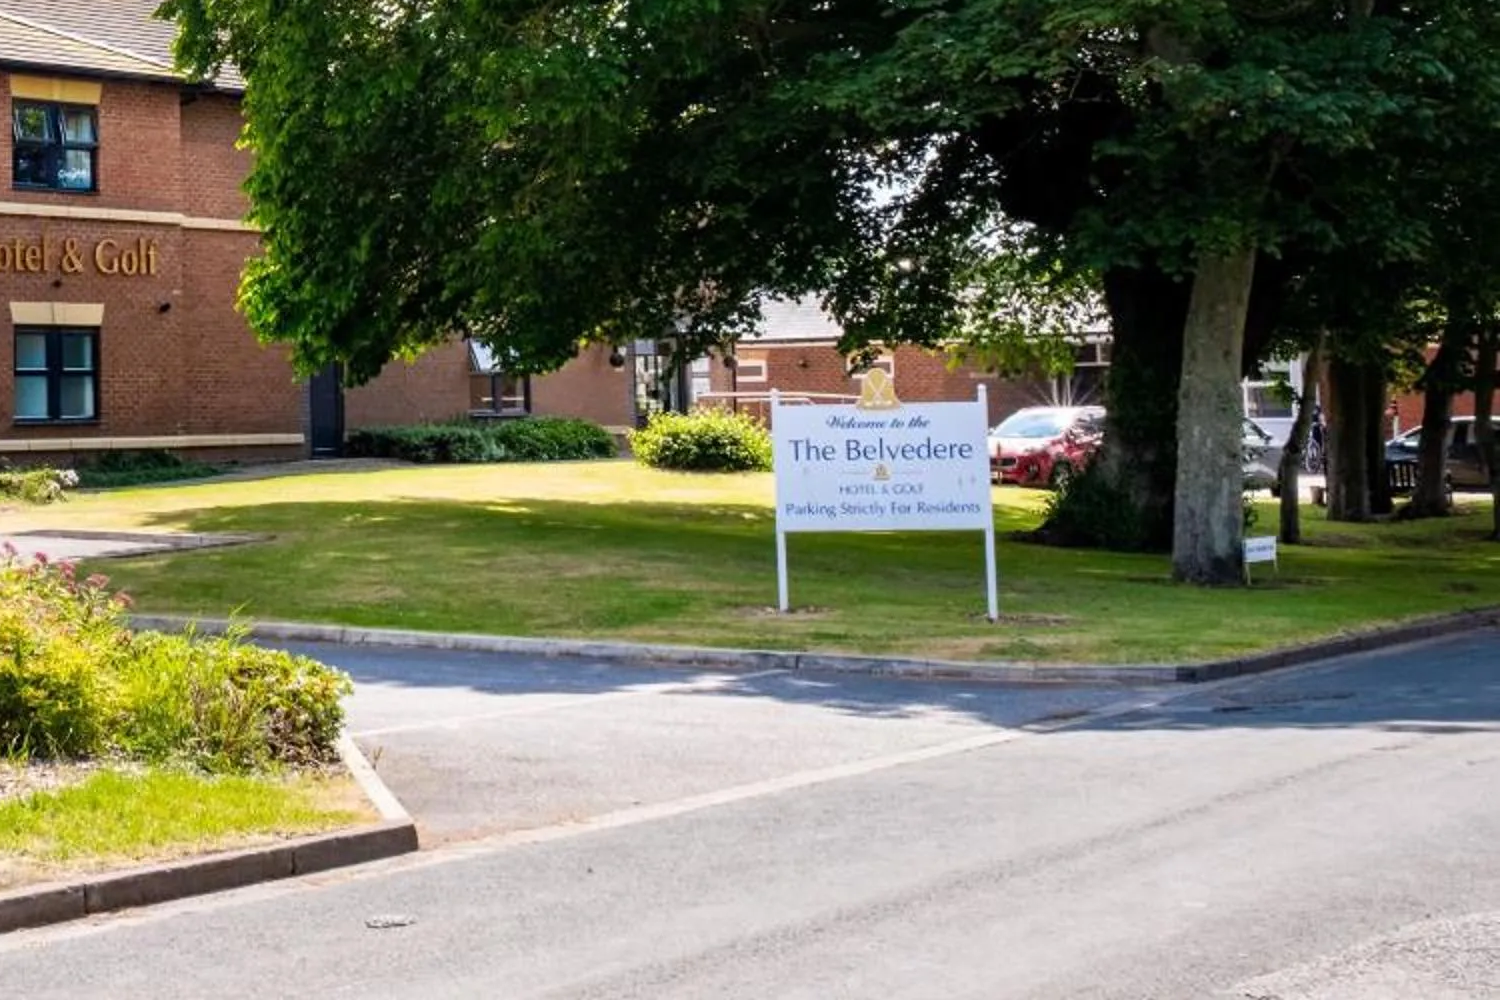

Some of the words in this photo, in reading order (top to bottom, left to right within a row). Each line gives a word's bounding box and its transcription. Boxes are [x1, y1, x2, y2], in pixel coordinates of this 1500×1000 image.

[61, 237, 85, 274] &
[95, 237, 160, 276] Golf
[890, 417, 905, 429] to
[908, 414, 931, 429] the
[788, 437, 836, 462] The
[845, 436, 974, 461] Belvedere
[785, 502, 837, 518] Parking
[840, 501, 886, 517] Strictly
[890, 501, 912, 515] For
[916, 500, 981, 514] Residents
